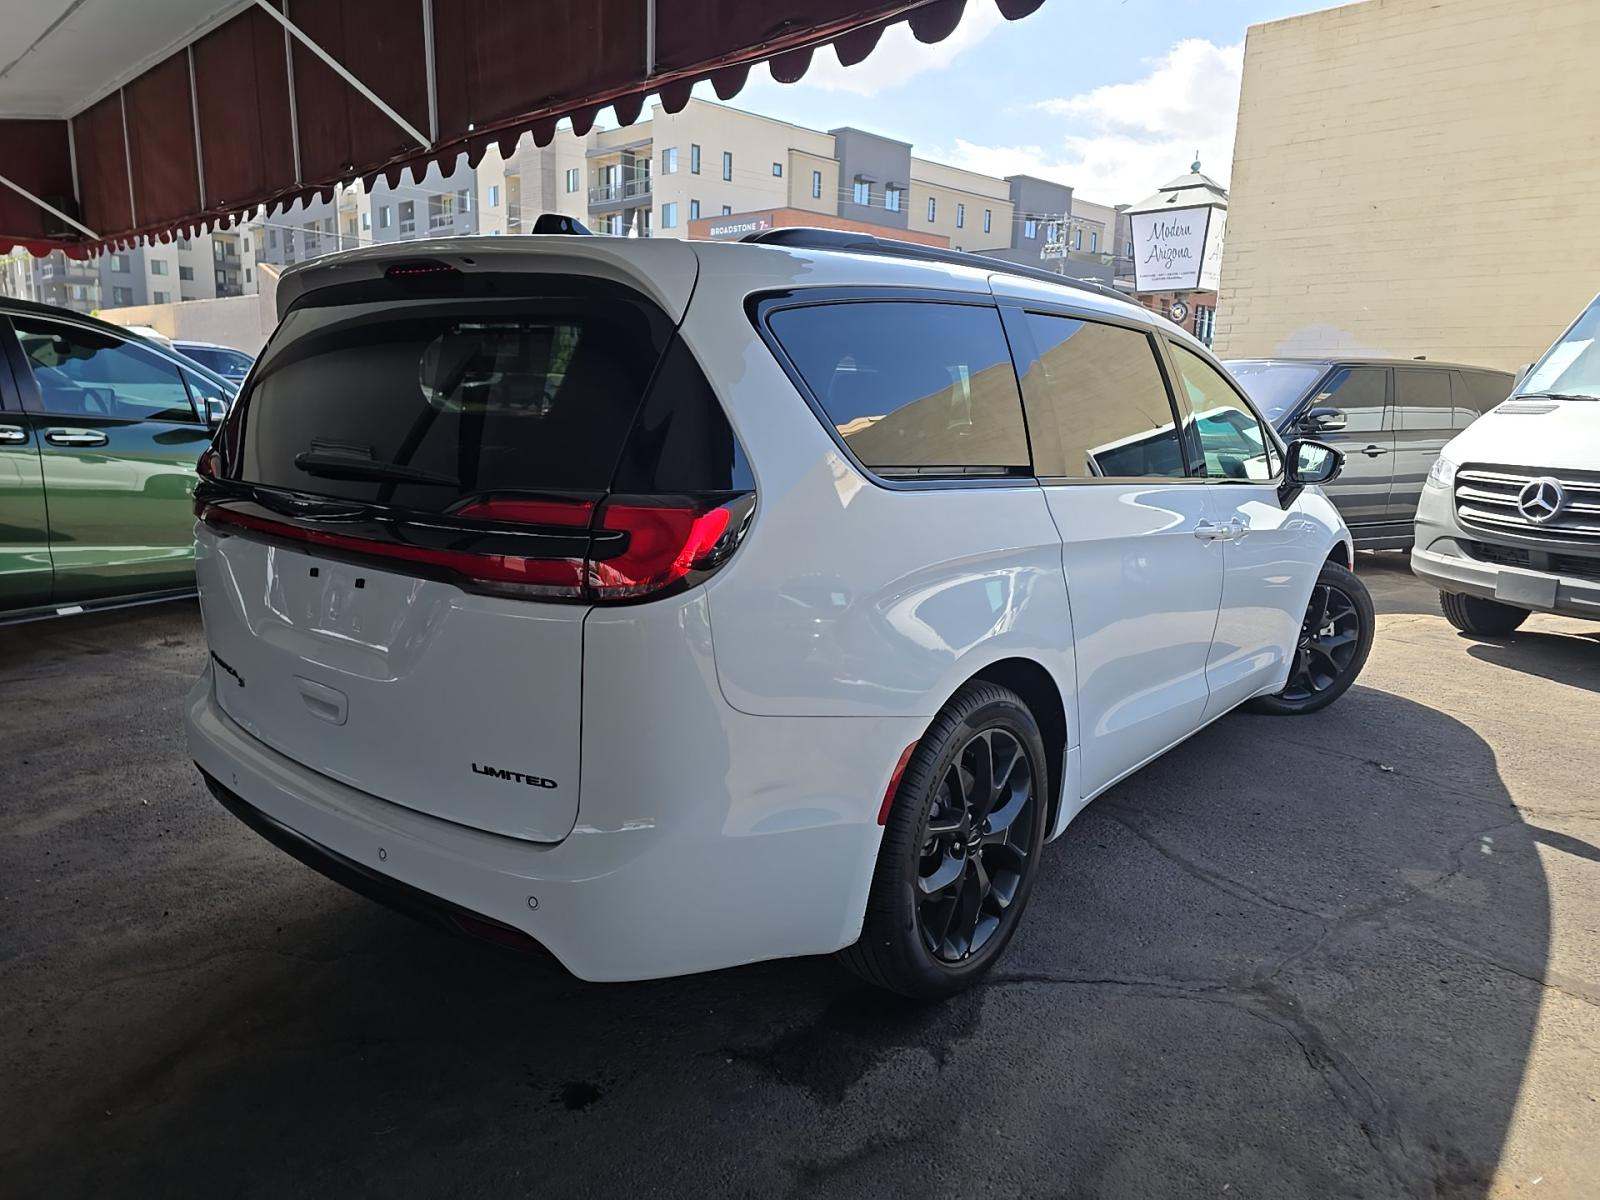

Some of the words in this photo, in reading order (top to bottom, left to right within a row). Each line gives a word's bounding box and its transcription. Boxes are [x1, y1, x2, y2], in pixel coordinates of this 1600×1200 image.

[710, 222, 757, 236] BROADSTONE
[1147, 217, 1192, 241] Modern
[1144, 243, 1193, 269] Arizona
[471, 763, 558, 789] LIMITED
